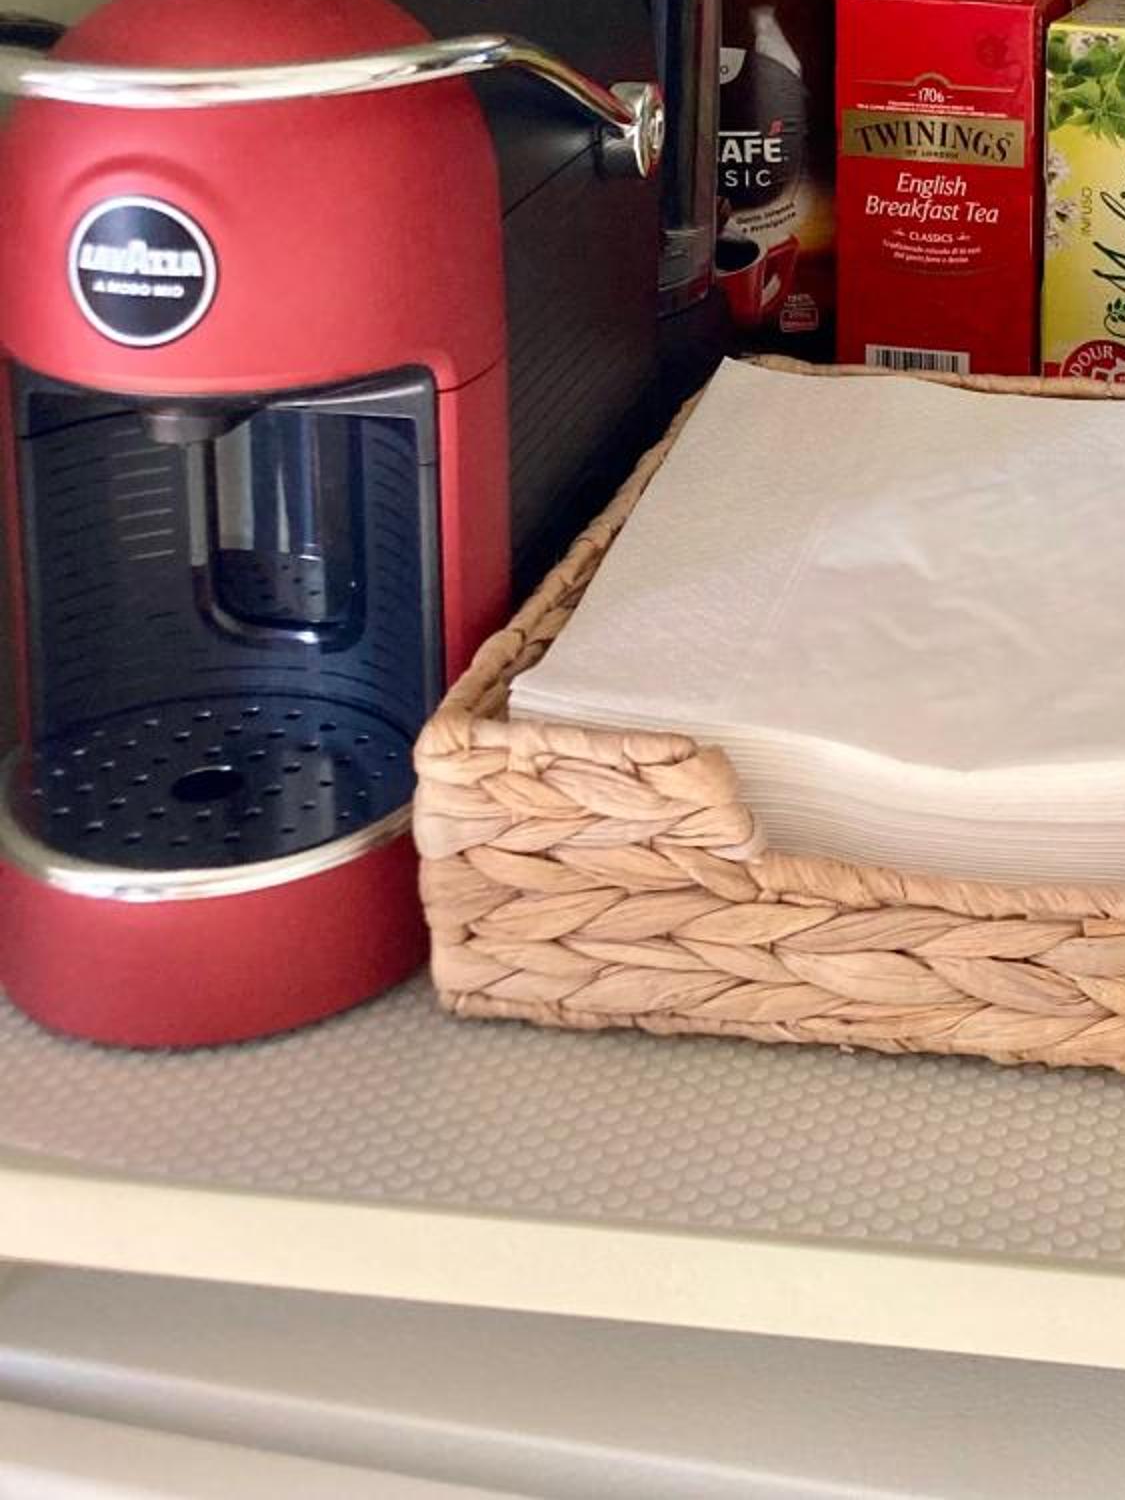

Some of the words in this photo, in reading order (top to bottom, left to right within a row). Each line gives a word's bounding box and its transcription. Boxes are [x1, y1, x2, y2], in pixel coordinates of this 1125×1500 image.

[856, 119, 1011, 163] TWININGS
[897, 172, 967, 199] English
[865, 195, 959, 223] Breakfast
[965, 201, 999, 224] Tea
